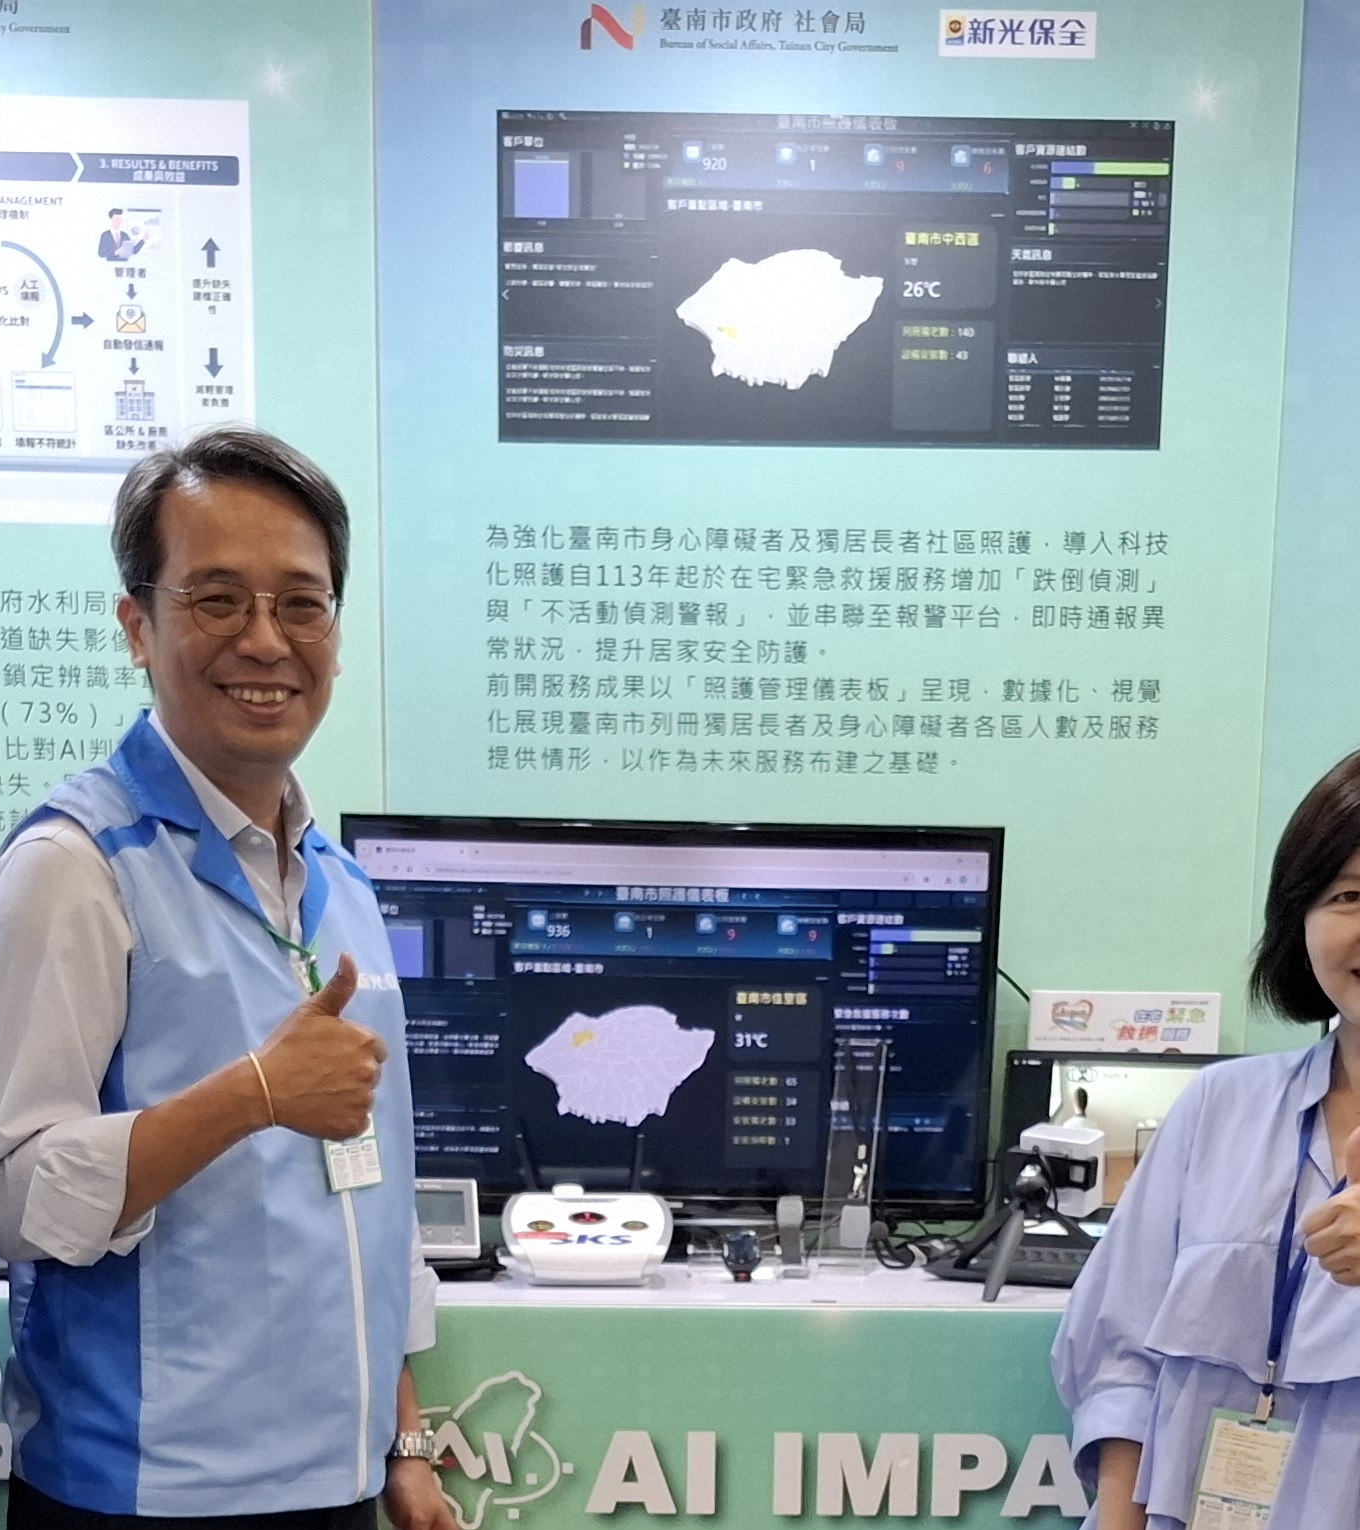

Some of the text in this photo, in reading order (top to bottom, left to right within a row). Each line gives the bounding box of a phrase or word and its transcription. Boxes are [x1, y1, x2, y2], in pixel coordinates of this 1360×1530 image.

[659, 8, 866, 35] 臺南市政府 社會局
[967, 17, 1087, 47] 新光保全
[659, 38, 694, 49] Bureau
[702, 158, 728, 171] 920
[546, 924, 571, 938] 936
[584, 1430, 716, 1516] AI
